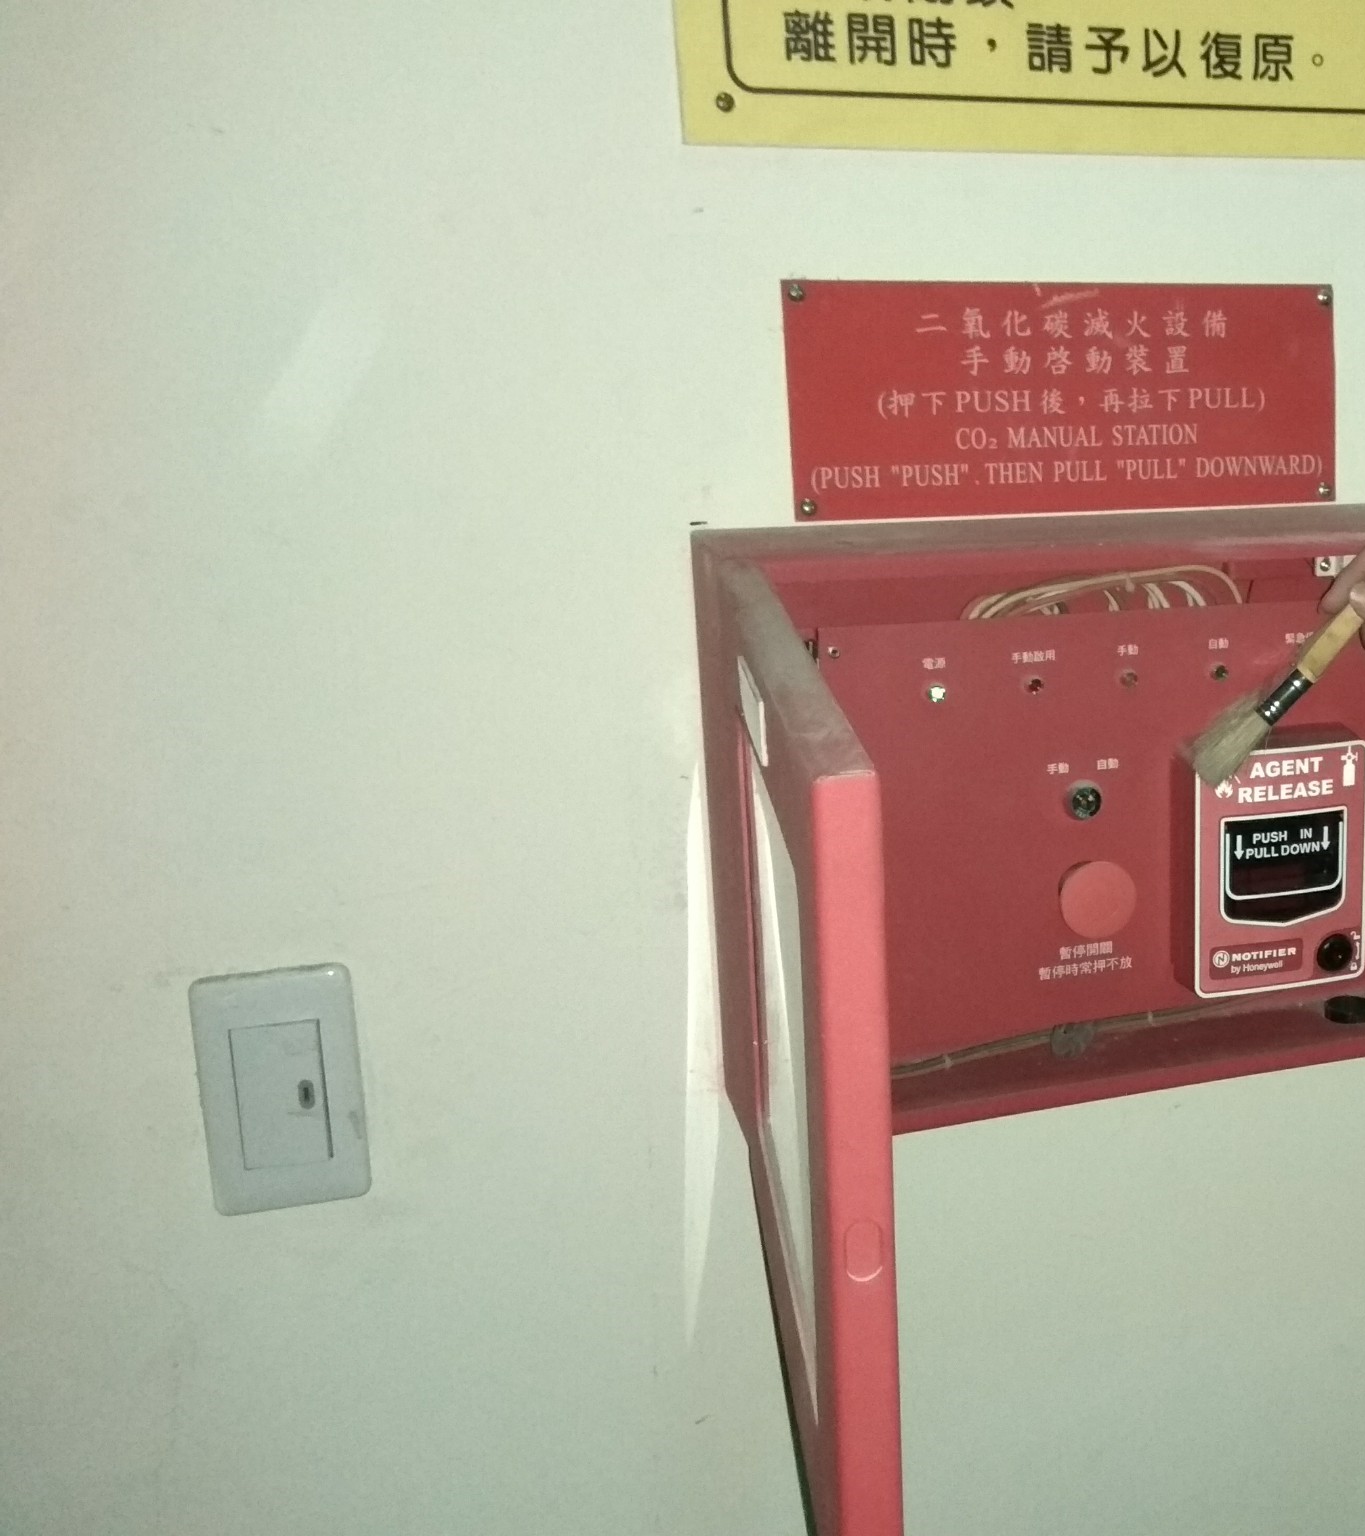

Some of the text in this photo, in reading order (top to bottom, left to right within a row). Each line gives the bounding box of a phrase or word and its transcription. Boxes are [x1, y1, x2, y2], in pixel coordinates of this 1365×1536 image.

[915, 306, 1229, 340] 二氧化碳滅火設備
[1007, 425, 1102, 448] MANUAL
[1111, 423, 1199, 446] STATION
[810, 465, 880, 494] (PUSH
[987, 462, 1044, 485] THEN
[1053, 461, 1107, 484] PULL
[1116, 458, 1186, 481] "PULL"
[1195, 454, 1324, 480] DOWNWARD)
[1117, 644, 1139, 657] 手動
[1208, 638, 1230, 650] 自動
[922, 657, 947, 671] 電源
[1046, 762, 1070, 775] 手動
[1096, 758, 1120, 771] 自動
[1249, 755, 1324, 780] AGENT
[1238, 778, 1334, 804] RELEASE
[1252, 827, 1313, 845] PUSH IN
[1245, 841, 1321, 860] PULL DOWN
[1231, 946, 1297, 963] NOTIFIER
[1230, 960, 1283, 975] by Honeywell
